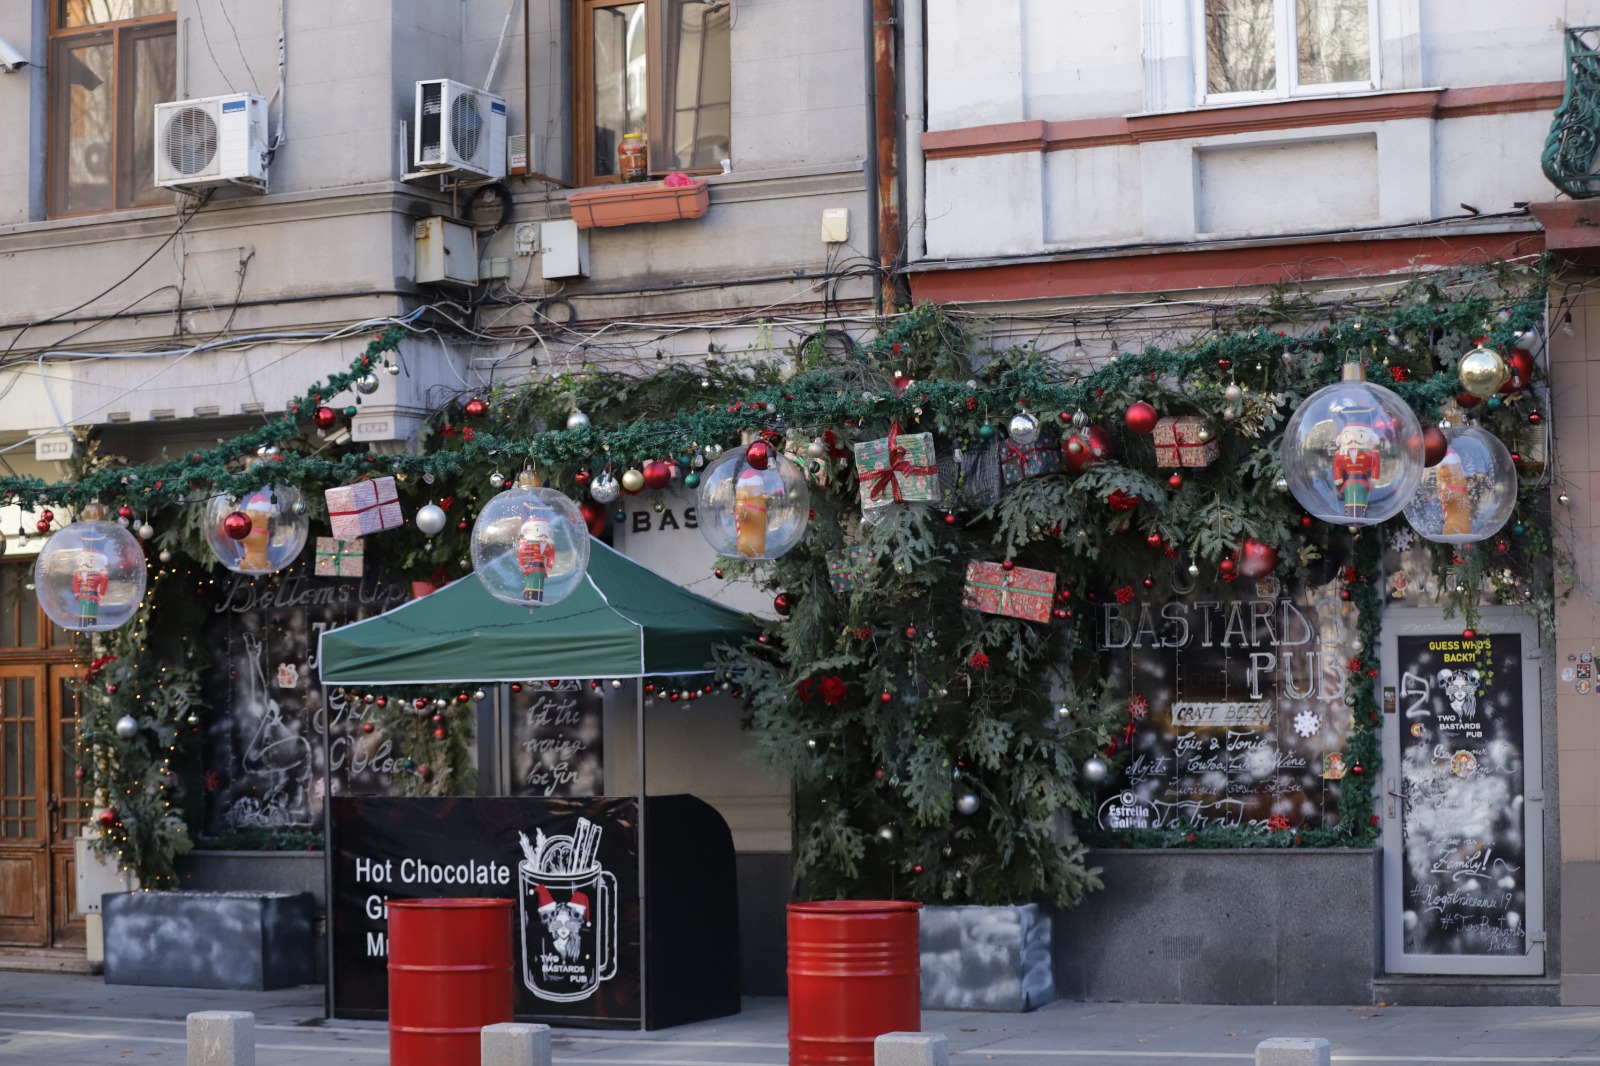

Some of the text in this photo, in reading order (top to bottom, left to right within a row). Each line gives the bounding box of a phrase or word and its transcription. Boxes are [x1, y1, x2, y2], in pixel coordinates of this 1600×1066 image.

[1102, 600, 1345, 648] BASTARDS
[1429, 641, 1459, 651] GUESS
[1444, 653, 1475, 662] BACK?!
[1249, 652, 1346, 700] PUB
[1177, 706, 1216, 722] CRAFT
[1176, 729, 1268, 757] Gin & Tonic
[1108, 804, 1149, 818] Estrella
[1109, 816, 1149, 829] Galicia
[356, 858, 510, 885] Hot Chocolate
[540, 953, 559, 963] TWO
[542, 965, 585, 973] BASTARDS
[570, 975, 588, 983] PUB
